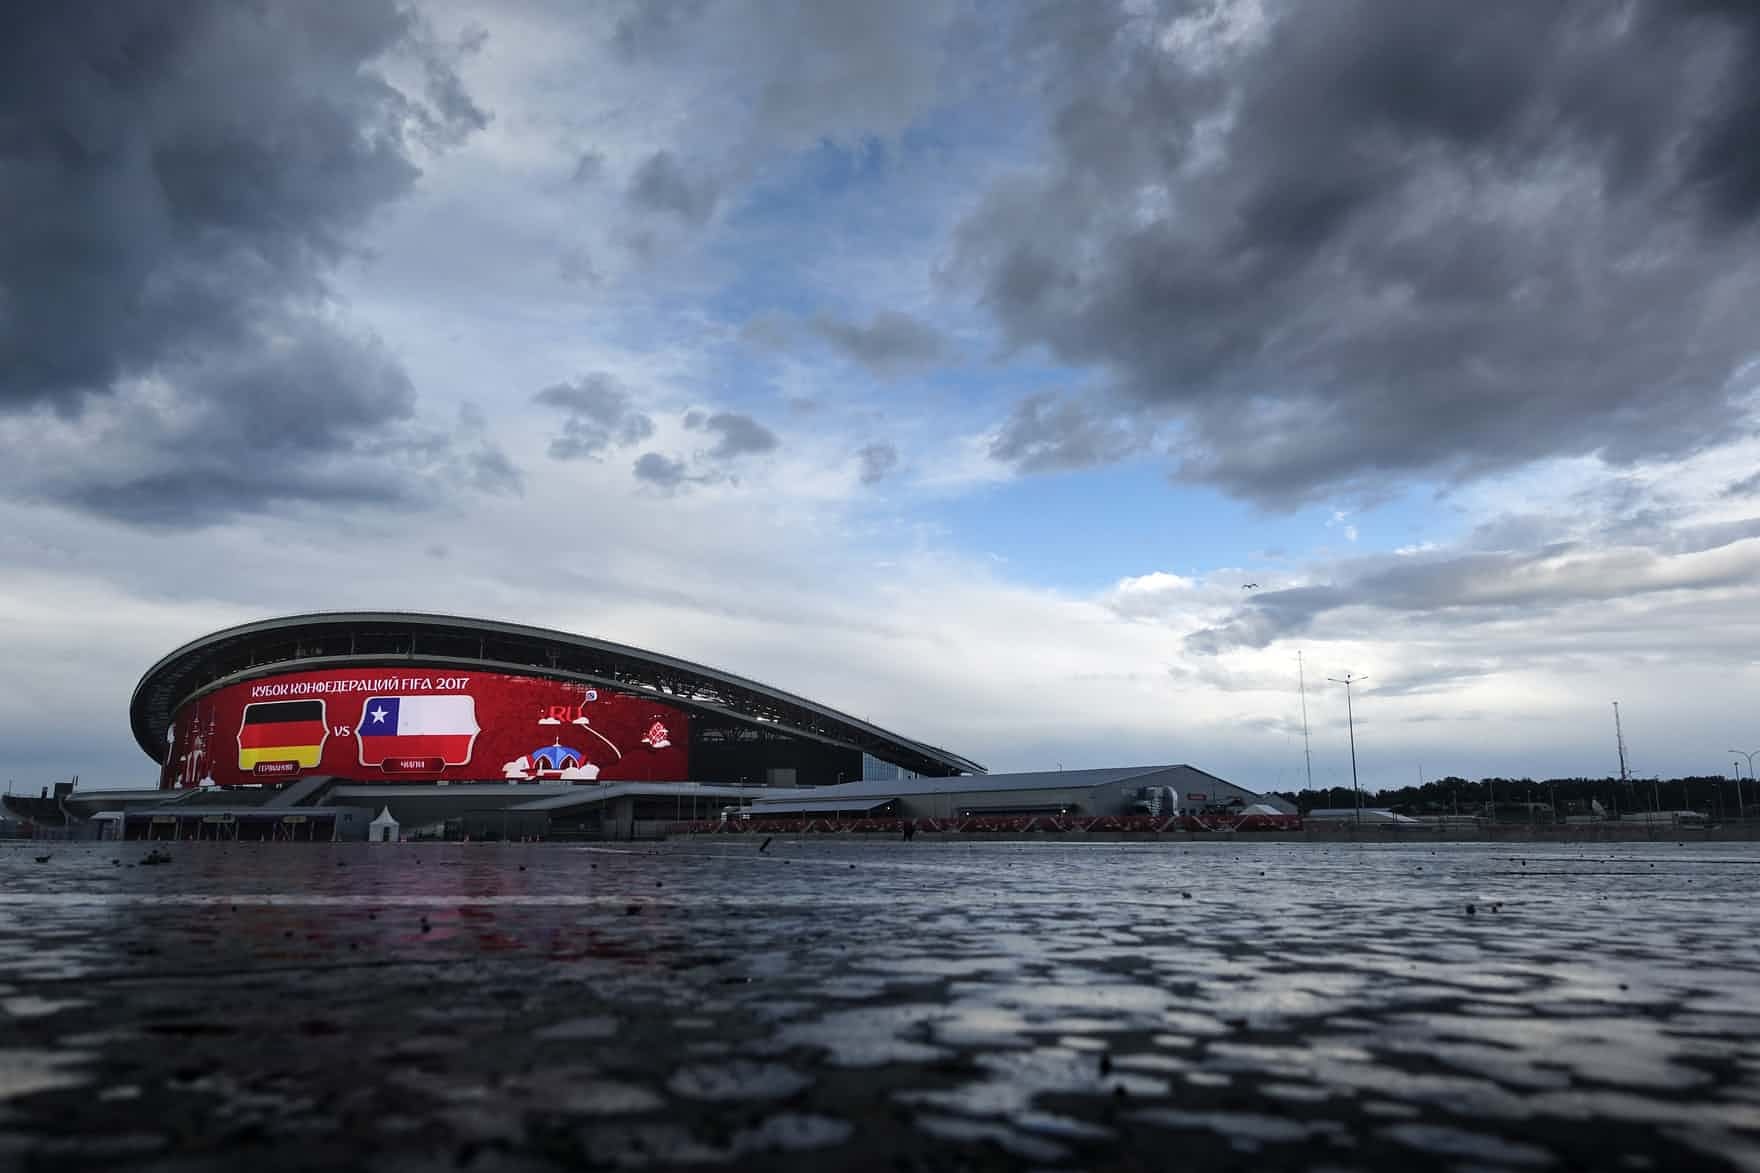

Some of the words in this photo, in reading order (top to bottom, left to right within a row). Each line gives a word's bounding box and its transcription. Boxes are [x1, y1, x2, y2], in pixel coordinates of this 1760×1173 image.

[251, 685, 289, 698] КУБОК
[290, 677, 399, 694] КОНФЕДЕРАЦИЙ
[401, 678, 433, 690] FIFA
[435, 677, 470, 690] 2017
